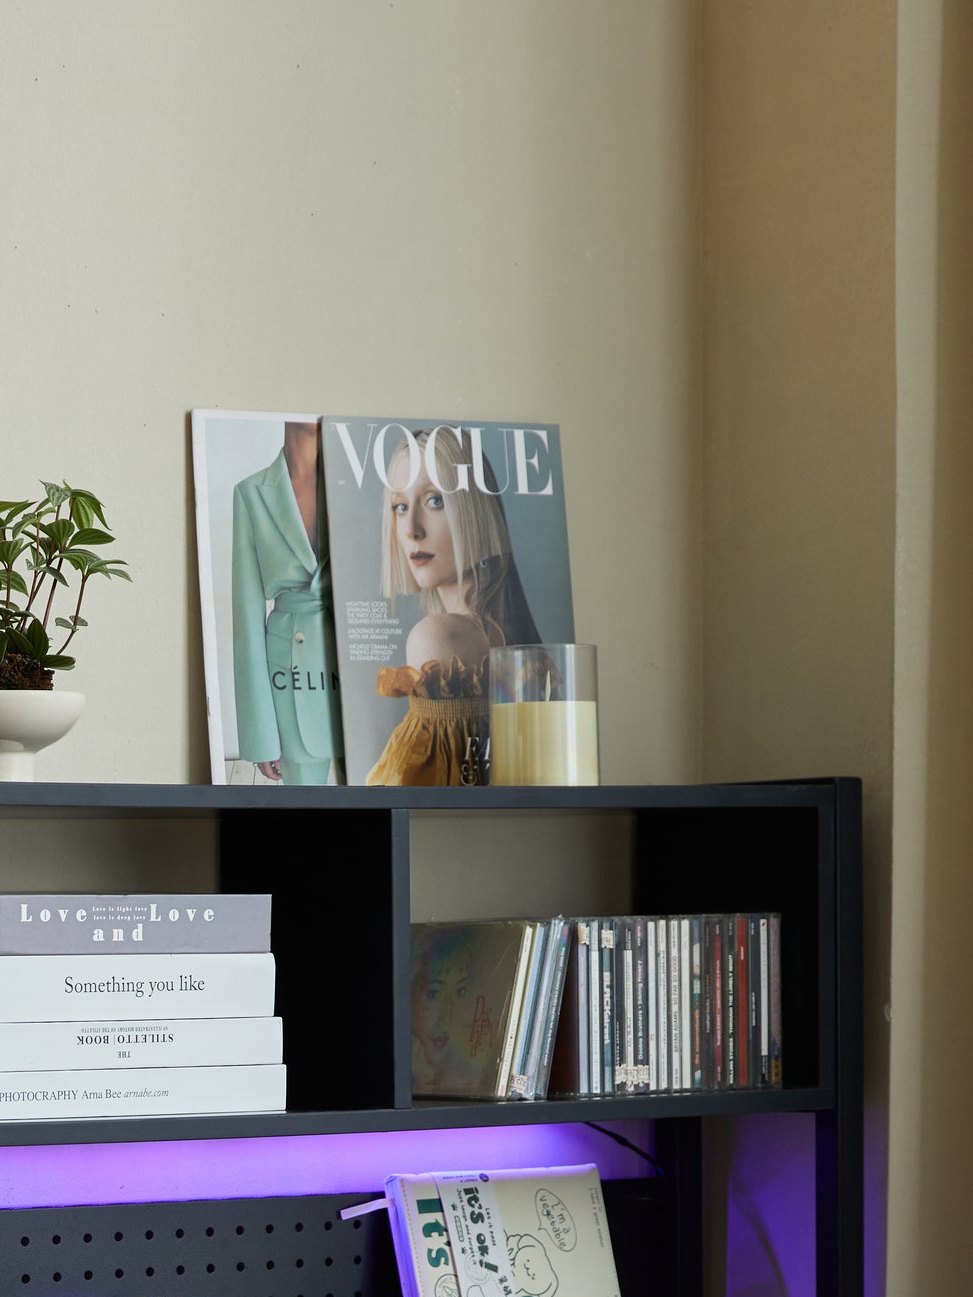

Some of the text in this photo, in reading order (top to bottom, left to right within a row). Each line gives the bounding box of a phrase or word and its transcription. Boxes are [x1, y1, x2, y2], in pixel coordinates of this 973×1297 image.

[332, 423, 553, 495] VOGUE
[20, 903, 215, 922] Love Love
[92, 923, 144, 942] and
[64, 974, 205, 998] Something you like
[77, 1033, 174, 1045] STILETTO BOOK
[105, 1089, 122, 1099] Bee
[124, 1088, 169, 1098] arnabe.com
[539, 1195, 566, 1248] vegetable
[416, 1198, 449, 1268] It's
